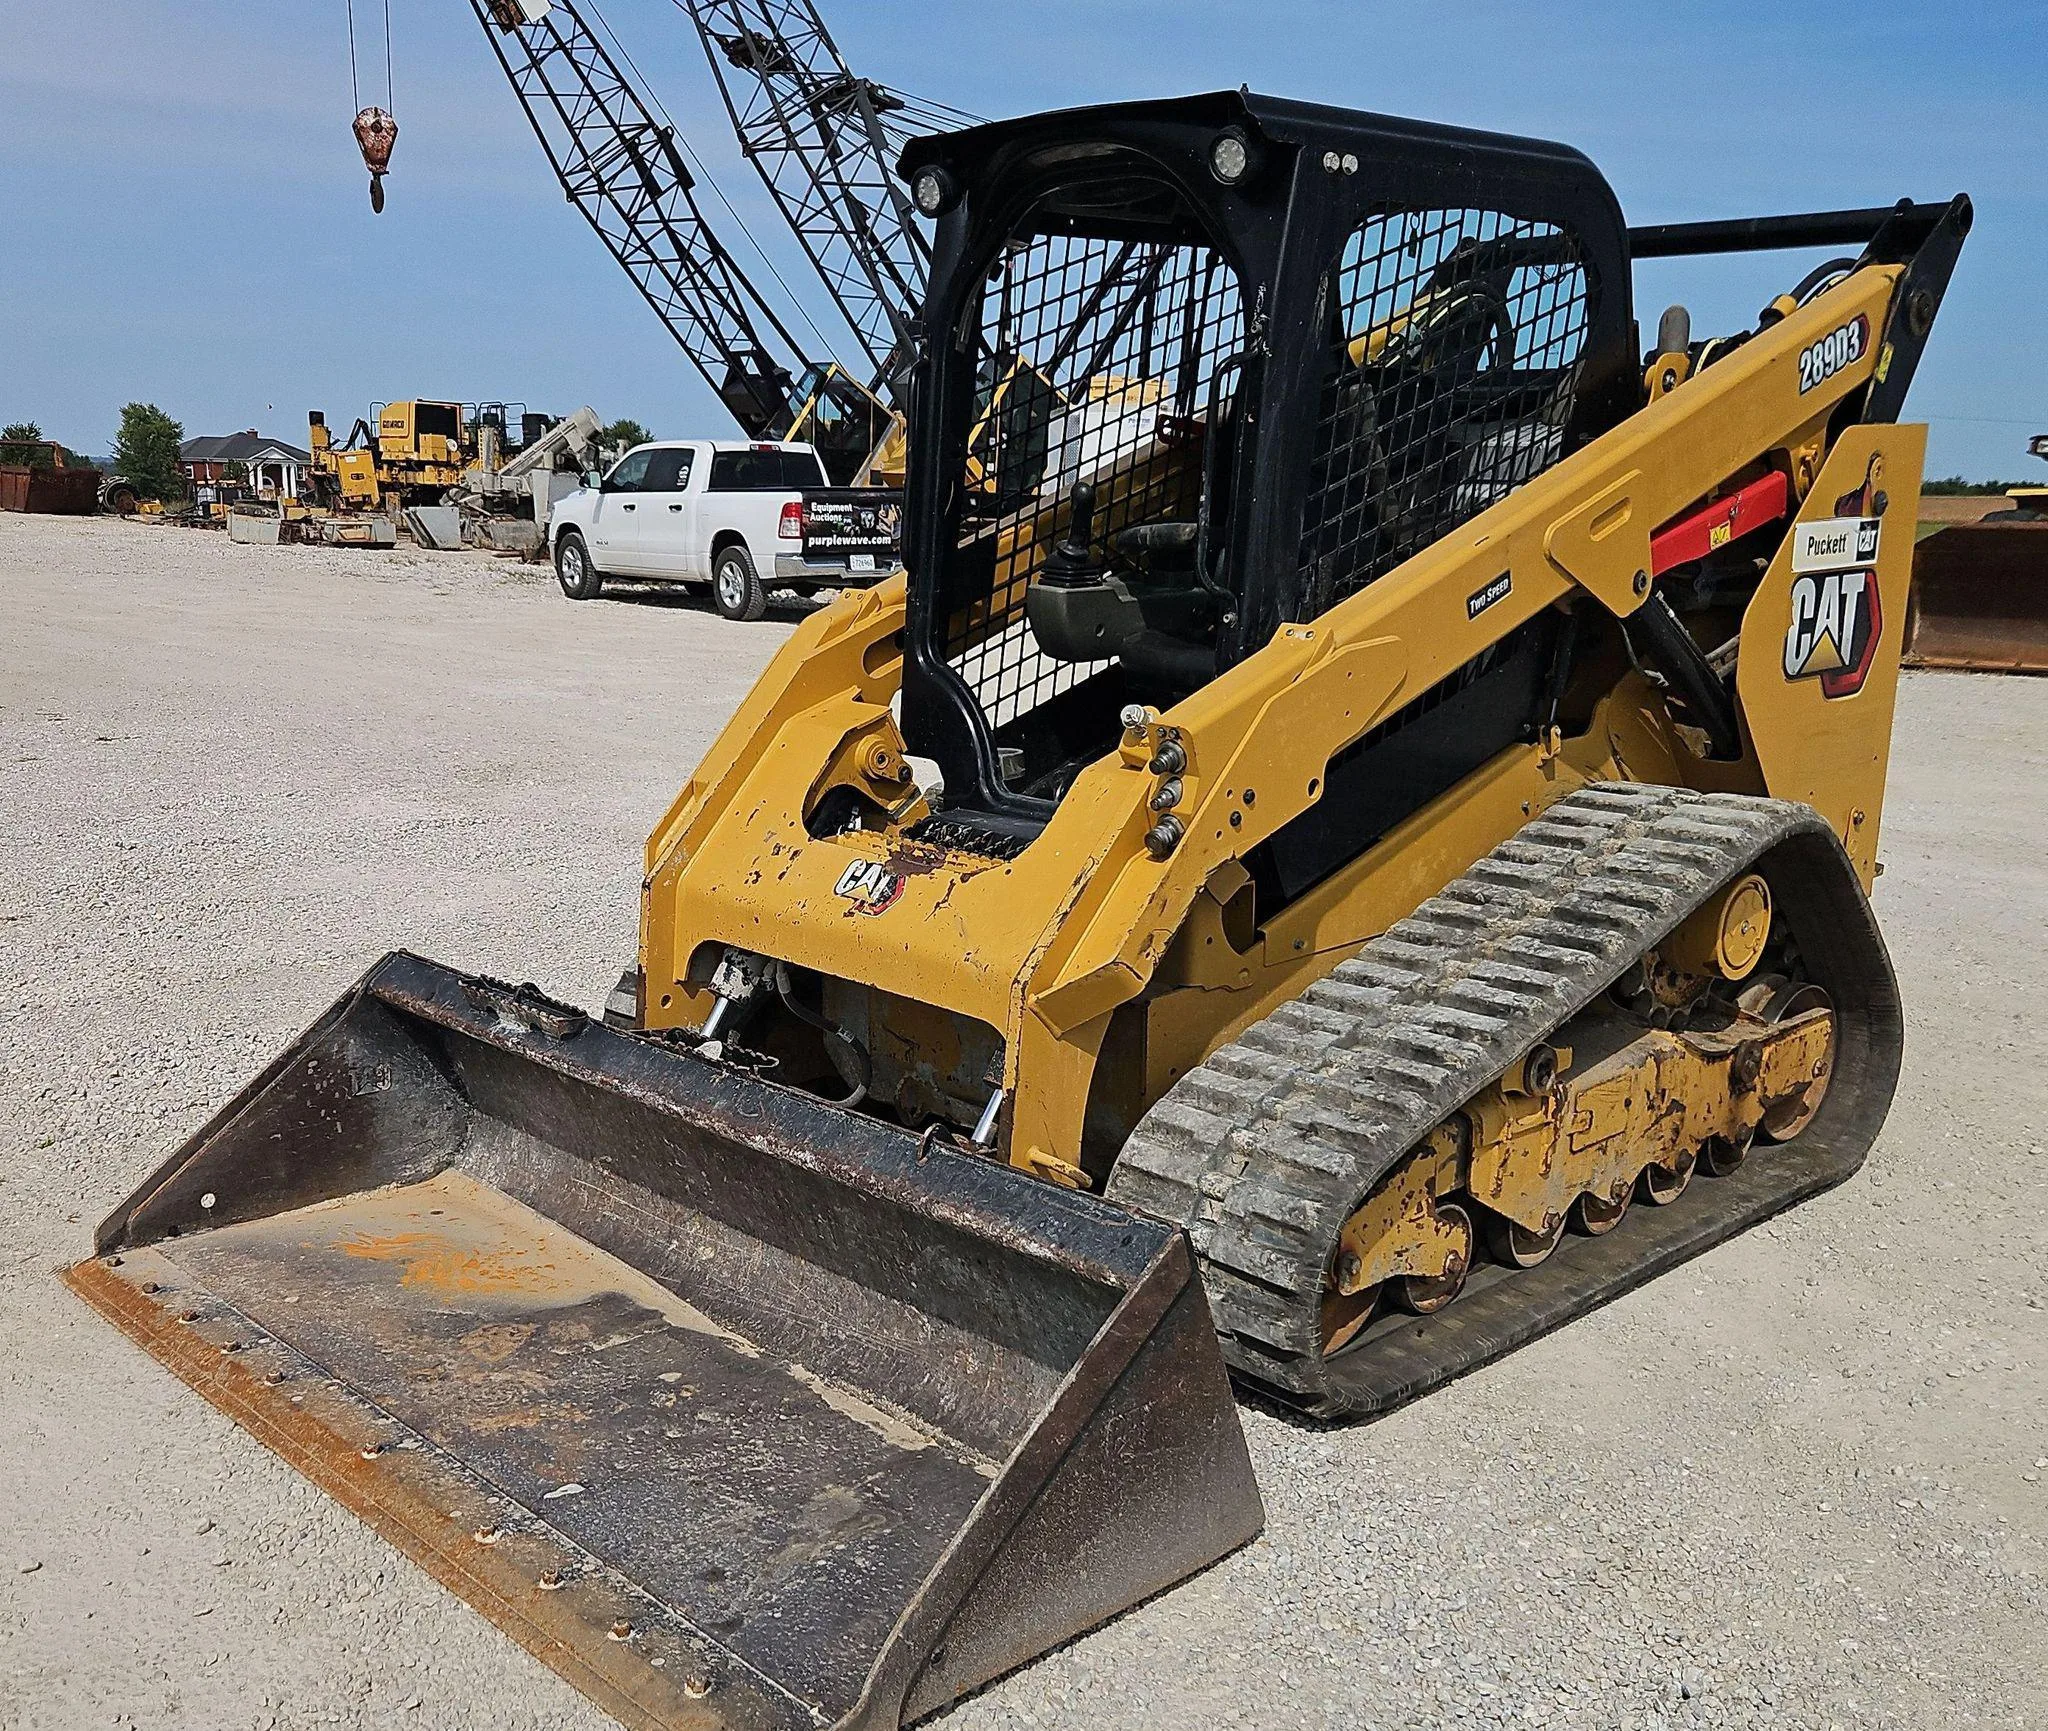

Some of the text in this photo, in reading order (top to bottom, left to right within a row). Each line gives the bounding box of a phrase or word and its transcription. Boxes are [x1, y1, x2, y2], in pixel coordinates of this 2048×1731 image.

[1799, 319, 1861, 393] 289D3
[810, 512, 842, 521] Auctions
[811, 502, 853, 513] Equipment
[808, 534, 892, 547] purplewave.com
[1807, 533, 1847, 556] Puckett
[1785, 573, 1866, 676] CAT
